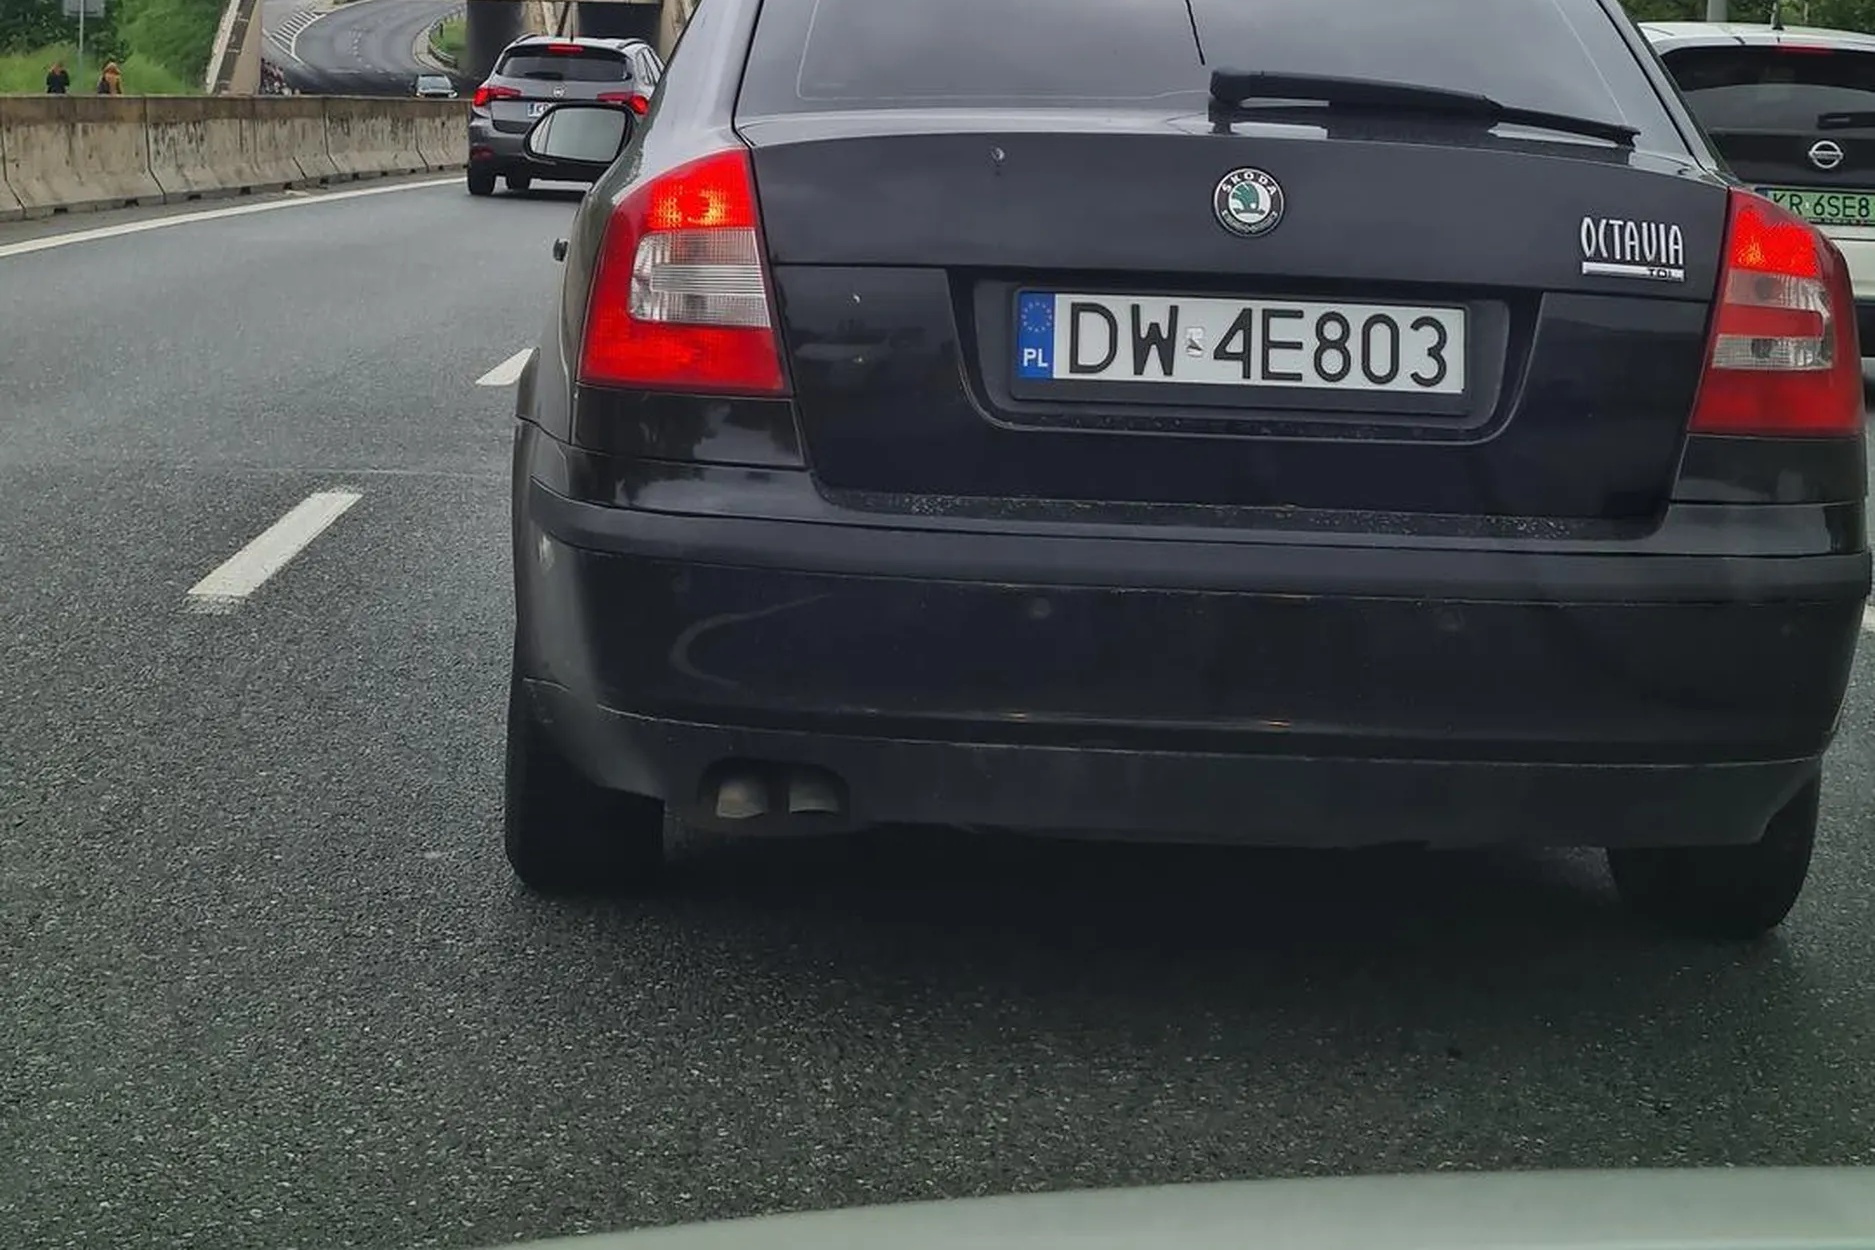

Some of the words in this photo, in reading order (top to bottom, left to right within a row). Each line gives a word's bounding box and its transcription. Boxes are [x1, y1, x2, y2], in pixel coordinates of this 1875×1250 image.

[1813, 195, 1870, 218] 6SE8
[1581, 217, 1683, 265] OCTAVIA
[1023, 348, 1048, 367] PL
[1069, 302, 1179, 376] DW
[1213, 307, 1448, 388] 4E803
